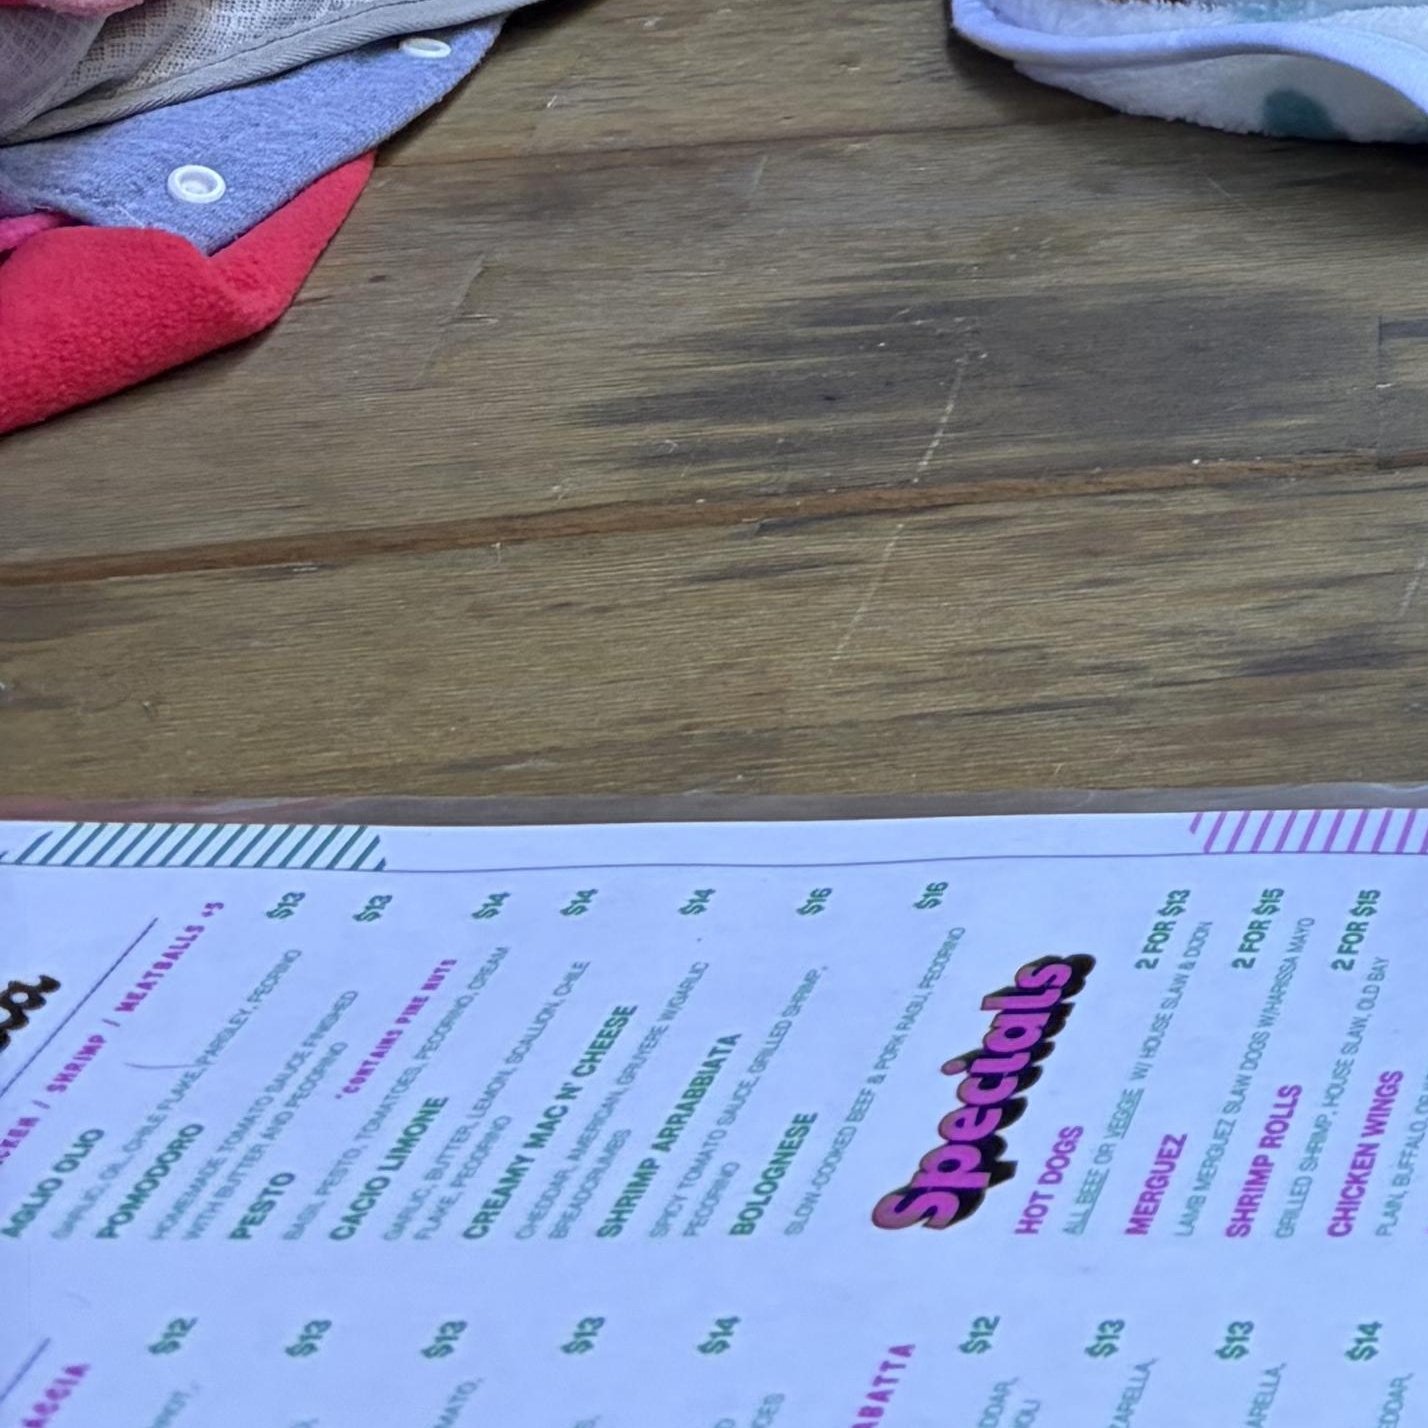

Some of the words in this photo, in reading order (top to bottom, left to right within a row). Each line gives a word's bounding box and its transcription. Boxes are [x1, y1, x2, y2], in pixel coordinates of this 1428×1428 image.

[265, 892, 306, 919] $13
[351, 894, 393, 922] $13
[470, 891, 511, 919] $14
[559, 888, 599, 916] $14
[677, 888, 717, 915] $14
[795, 887, 833, 916] $16
[912, 881, 949, 909] $16
[1156, 889, 1191, 916] $13
[1251, 888, 1285, 915] $15
[1348, 889, 1382, 917] $15
[1141, 920, 1177, 953] FOR
[1237, 919, 1273, 953] FOR
[1336, 921, 1370, 954] FOR
[918, 926, 967, 988] PECORINO
[1133, 958, 1160, 969] 2
[1177, 961, 1197, 970] &
[1230, 957, 1257, 969] 2
[1330, 958, 1356, 970] 2
[1366, 956, 1389, 981] BAY
[45, 1034, 107, 1092] SHRIMP
[114, 924, 205, 1012] MEATBALLS
[394, 995, 430, 1023] PINE
[420, 959, 458, 990] NUTS
[1159, 973, 1190, 1008] SLAW
[1356, 984, 1381, 1009] OLD
[895, 991, 933, 1030] RAGU,
[873, 1033, 909, 1069] PORK
[1138, 1013, 1175, 1058] HOUSE
[1340, 1013, 1372, 1054] SLAW,
[865, 1074, 887, 1084] &
[1128, 1062, 1154, 1080] W/
[1173, 1196, 1207, 1236] LAMB
[1191, 1118, 1237, 1191] MERGUEZ
[1221, 1075, 1253, 1113] SLAW
[1238, 1031, 1271, 1070] DOGS
[1256, 956, 1300, 1027] W/HARISSA
[1285, 917, 1316, 952] MAYO
[1321, 1058, 1356, 1105] HOUSE
[844, 1087, 876, 1122] BEEF
[869, 954, 1097, 1230] Specials
[148, 1157, 227, 1240] HOMEMADE
[215, 1095, 275, 1153] TOMATO
[263, 1050, 313, 1092] SAUCE
[301, 990, 359, 1046] FINISHED
[461, 1155, 536, 1239] CREAMY
[521, 1105, 569, 1148] MAC
[570, 1005, 638, 1077] CHEESE
[1103, 1087, 1142, 1139] VEGGIE
[181, 1201, 225, 1240] WITH
[212, 1143, 271, 1197] BUTTER
[260, 1111, 295, 1139] AND
[283, 1041, 349, 1107] PECORINO
[595, 1157, 661, 1238] SHRIMP
[650, 1033, 742, 1152] ARRABBIATA
[1092, 1143, 1117, 1163] OR
[1297, 1110, 1337, 1171] SHRIMP,
[1326, 1142, 1381, 1237] CHICKEN
[1360, 1070, 1404, 1137] WINGS
[328, 1176, 391, 1240] CACIO
[376, 1096, 449, 1170] LIMONE
[412, 1191, 463, 1239] FLAKE,
[448, 1115, 513, 1187] PECORINO
[728, 1112, 818, 1235] BOLOGNESE
[783, 1125, 858, 1234] SLOW-COOKED
[1013, 1190, 1055, 1234] HOT
[1036, 1125, 1084, 1184] DOGS
[1224, 1154, 1275, 1237] SHRIMP
[1257, 1084, 1303, 1148] ROLLS
[0, 1178, 64, 1238] AGLIO
[51, 1129, 105, 1172] OLIO
[95, 1123, 205, 1238] POMODORO
[547, 1129, 633, 1238] BREADCRUMBS
[681, 1161, 741, 1236] PECORINO
[1073, 1167, 1108, 1204] BEEF
[1124, 1133, 1188, 1234] MERGUEZ
[227, 1172, 296, 1239] PESTO
[1061, 1211, 1089, 1234] ALL
[1273, 1175, 1314, 1238] GRILLED
[1374, 1190, 1407, 1236] PLAIN,
[147, 1317, 198, 1355] $12
[284, 1319, 333, 1357] $13
[420, 1320, 468, 1358] $13
[559, 1316, 606, 1354] $13
[696, 1316, 742, 1354] $14
[957, 1315, 1001, 1353] $12
[1084, 1319, 1126, 1358] $13
[1214, 1320, 1255, 1360] $13
[1344, 1321, 1383, 1361] $14
